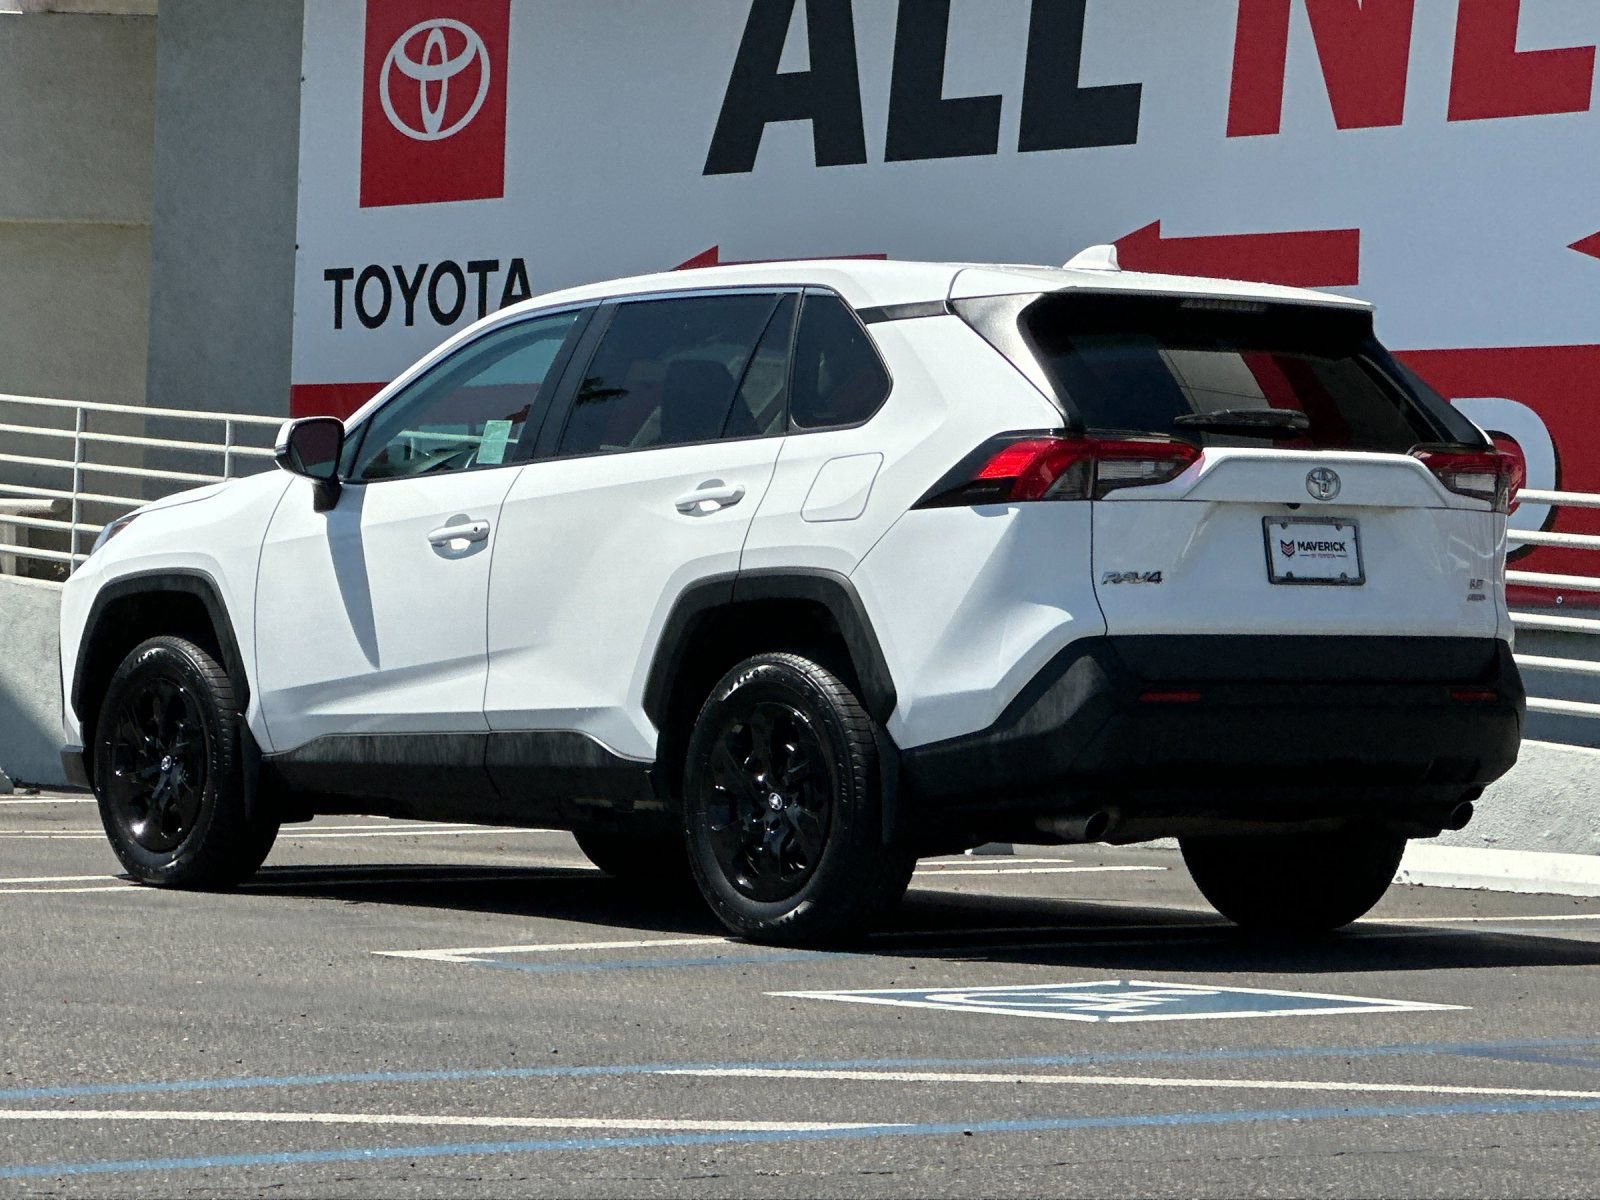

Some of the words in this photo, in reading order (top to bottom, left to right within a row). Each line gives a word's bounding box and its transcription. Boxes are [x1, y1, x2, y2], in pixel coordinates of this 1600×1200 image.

[702, 0, 1142, 175] ALL
[323, 257, 534, 330] TOYOTA
[1297, 541, 1347, 552] MAVERICK
[1101, 570, 1163, 585] RAV4
